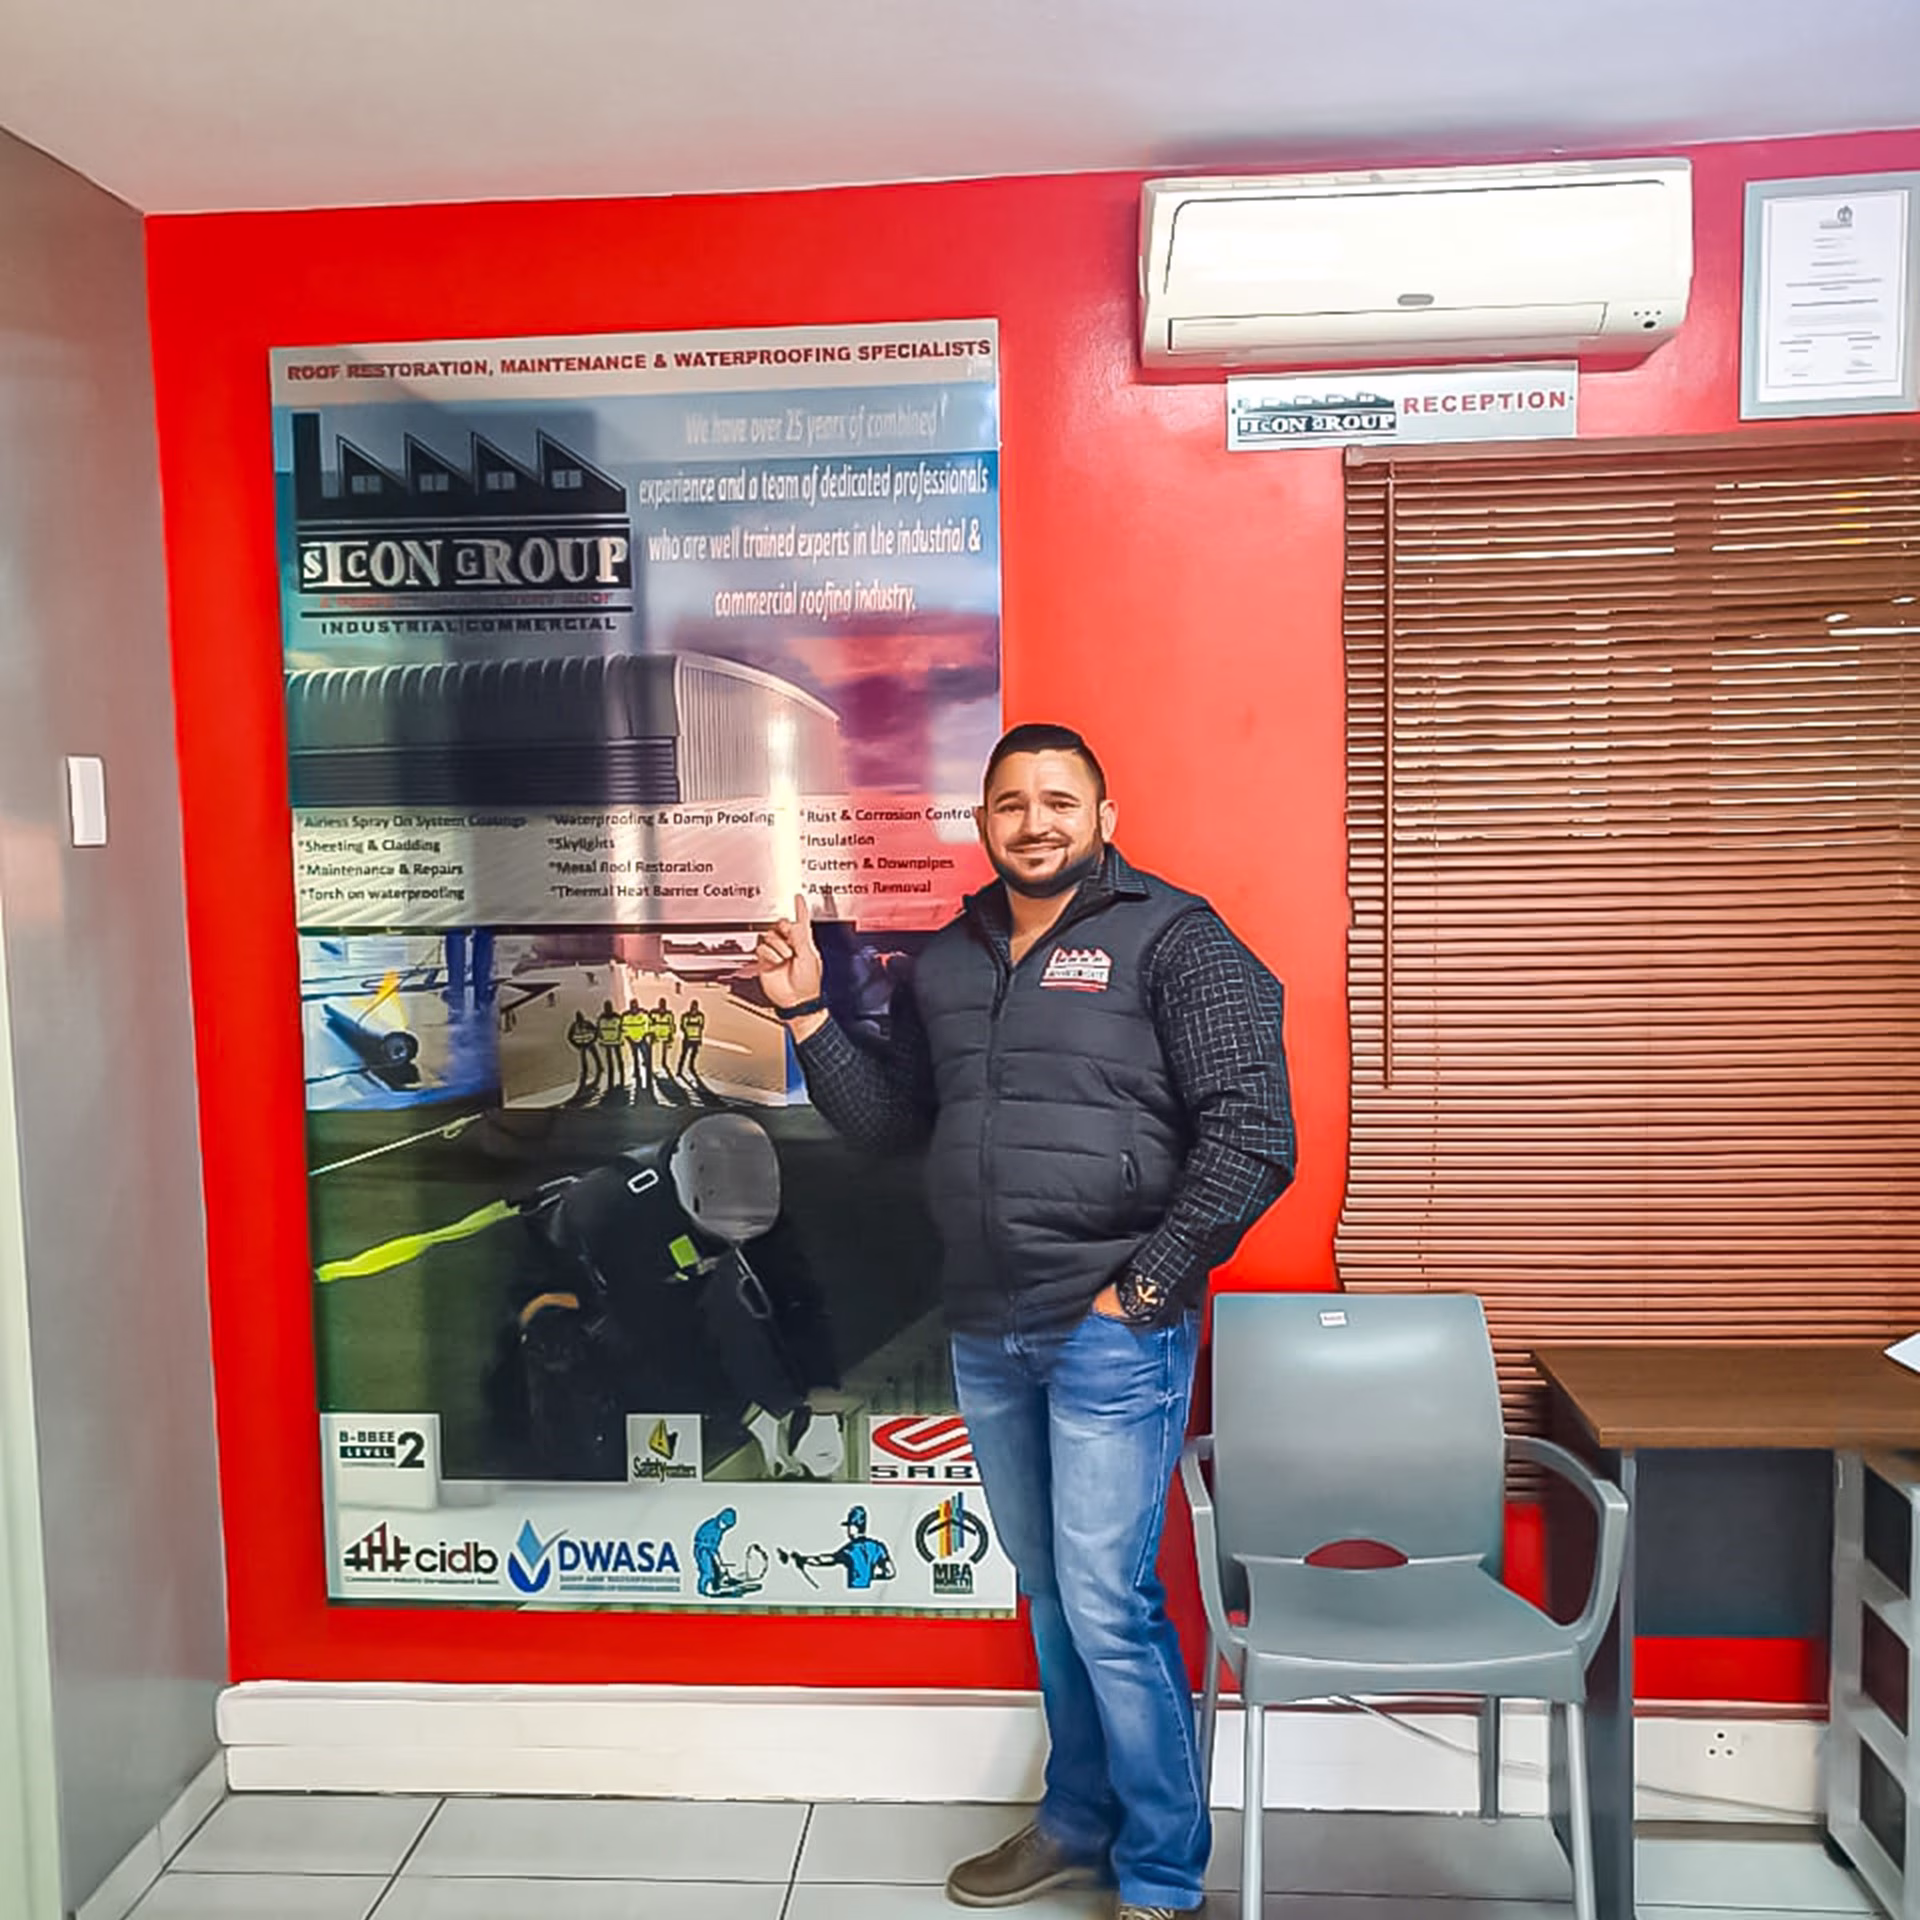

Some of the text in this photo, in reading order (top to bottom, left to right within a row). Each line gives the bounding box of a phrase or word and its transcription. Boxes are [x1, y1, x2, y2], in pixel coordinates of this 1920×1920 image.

[287, 339, 991, 380] ROOF RESTORATION, MAINTENANCE & WATERPROOFING SPECIALISTS
[1403, 391, 1565, 414] RECEPTION
[685, 413, 708, 444] We
[751, 418, 783, 441] over
[786, 409, 803, 442] 25
[807, 414, 845, 448] years
[849, 405, 865, 446] of
[1240, 417, 1308, 434] ICON
[639, 458, 989, 510] experience and a team of dedicated professionals
[648, 517, 981, 565] who are well trained experts in the industrial &
[302, 536, 627, 587] SICON GROUP
[715, 579, 916, 621] commercial roofing industry.
[352, 815, 390, 829] Spray
[393, 815, 412, 827] On
[416, 815, 464, 830] System
[553, 811, 775, 827] Waterproofing & Damp Proofing
[807, 810, 837, 822] Rust
[840, 809, 851, 820] &
[855, 808, 921, 821] Corrosion
[305, 838, 440, 854] Sheeting & Cladding
[556, 836, 616, 852] Skylights
[807, 833, 876, 847] Insulation
[307, 864, 464, 878] Maintenance & Repairs
[635, 861, 714, 873] Restoration
[807, 857, 955, 871] Gutters & Downpipes
[309, 886, 464, 902] Torch on waterproofing
[559, 884, 761, 898] Thermal Heat Barrier Coatings
[808, 880, 932, 895] Asbestos Removal
[340, 1431, 395, 1442] B-BBEE
[346, 1447, 390, 1457] LEVEL
[397, 1431, 425, 1469] 2
[415, 1542, 499, 1574] cidb
[559, 1541, 681, 1573] DWASA
[933, 1563, 973, 1580] MBA
